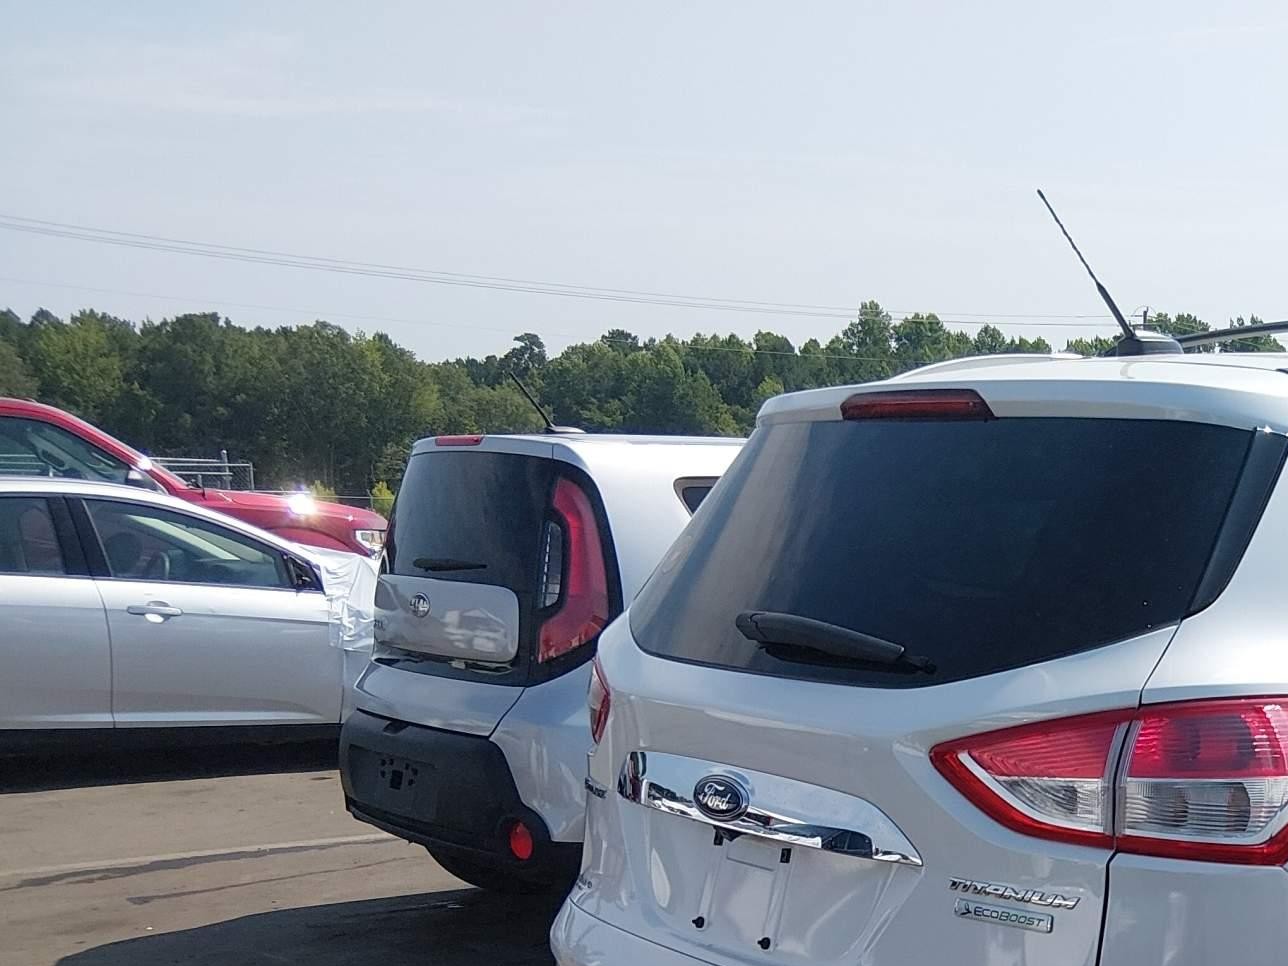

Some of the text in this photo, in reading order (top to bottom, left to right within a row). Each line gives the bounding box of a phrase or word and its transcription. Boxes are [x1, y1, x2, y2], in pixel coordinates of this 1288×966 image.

[698, 782, 731, 810] Ford
[949, 877, 1081, 910] TITANIUM
[973, 906, 1044, 928] ECOBOOST
